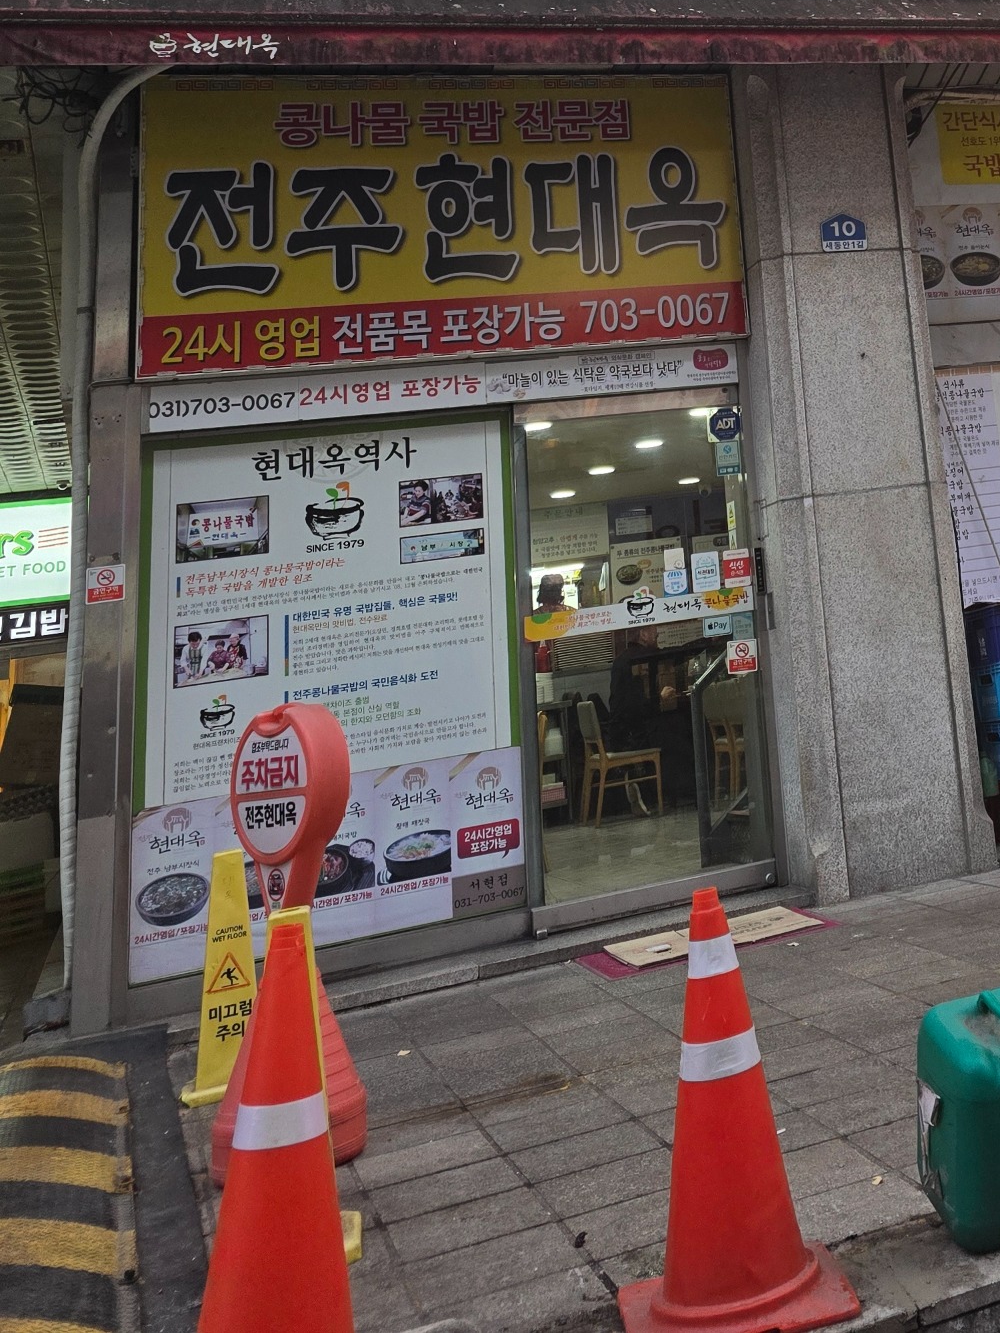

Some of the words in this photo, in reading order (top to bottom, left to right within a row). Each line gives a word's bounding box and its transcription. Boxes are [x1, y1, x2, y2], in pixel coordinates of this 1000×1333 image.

[182, 33, 281, 60] 현대옥
[275, 102, 411, 149] 콩나물
[417, 100, 505, 144] 국밥
[512, 97, 631, 142] 전문점
[960, 137, 986, 147] 선호도
[161, 146, 728, 298] 전주현대옥
[830, 221, 856, 237] 10
[955, 222, 992, 238] 현대옥
[161, 320, 242, 365] 24시
[254, 316, 321, 364] 영업
[331, 307, 430, 354] 전품목
[439, 301, 566, 344] 포장가능
[579, 291, 731, 336] 703-0067
[546, 369, 569, 386] 있는
[572, 366, 606, 384] 식탁은
[609, 363, 653, 381] 약국보다
[299, 383, 392, 407] 24시영업
[400, 374, 479, 398] 포장가능
[715, 415, 736, 430] ADT
[251, 436, 418, 482] 현대옥역사
[306, 541, 335, 553] SINCE
[337, 539, 365, 550] 1979
[22, 560, 67, 576] FOOD
[9, 608, 68, 641] 김밥
[251, 738, 289, 753] 협조부탁드립니다
[241, 754, 299, 790] 주차금지
[149, 830, 202, 855] 현대옥
[391, 788, 438, 807] 현대옥
[465, 787, 514, 809] 현대옥
[245, 801, 297, 830] 전주현대옥
[464, 824, 513, 843] 24시간영업
[470, 838, 507, 852] 포장가능
[469, 873, 508, 889] 서현점
[454, 886, 524, 909] 031-703-0067
[212, 933, 226, 943] WET
[227, 930, 247, 941] FLOOR
[215, 925, 243, 936] CAUTION
[208, 999, 254, 1023] 미끄럼
[215, 1020, 246, 1042] 주의
